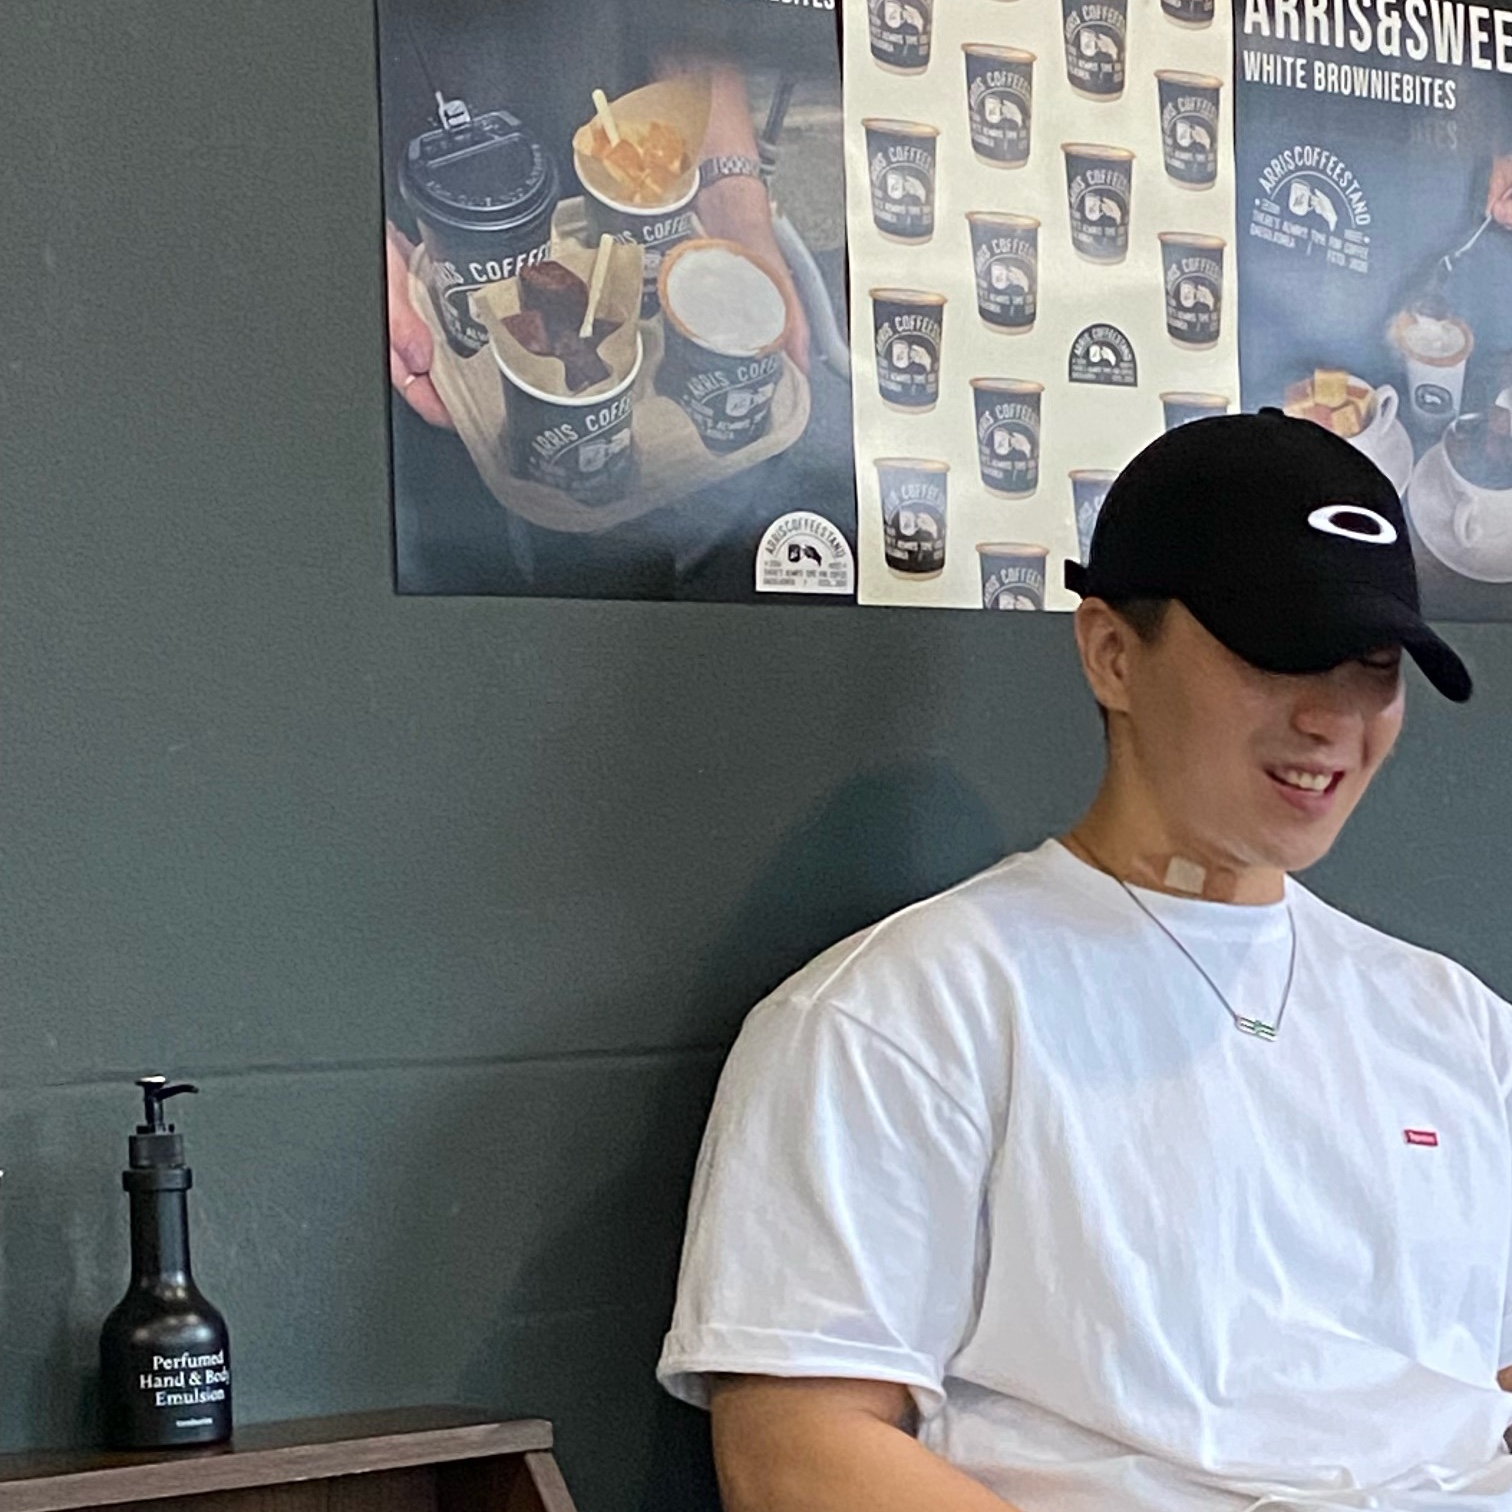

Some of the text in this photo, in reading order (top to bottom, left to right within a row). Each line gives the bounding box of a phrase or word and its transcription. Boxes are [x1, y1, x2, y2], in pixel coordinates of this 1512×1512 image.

[1243, 49, 1457, 110] WHITE BROWNIEBITES
[1258, 145, 1372, 226] ARRISCOFFEESTAND
[152, 1348, 225, 1371] Perfumed
[139, 1370, 186, 1389] Hand
[188, 1370, 203, 1386] &
[154, 1386, 225, 1407] Emulsion
